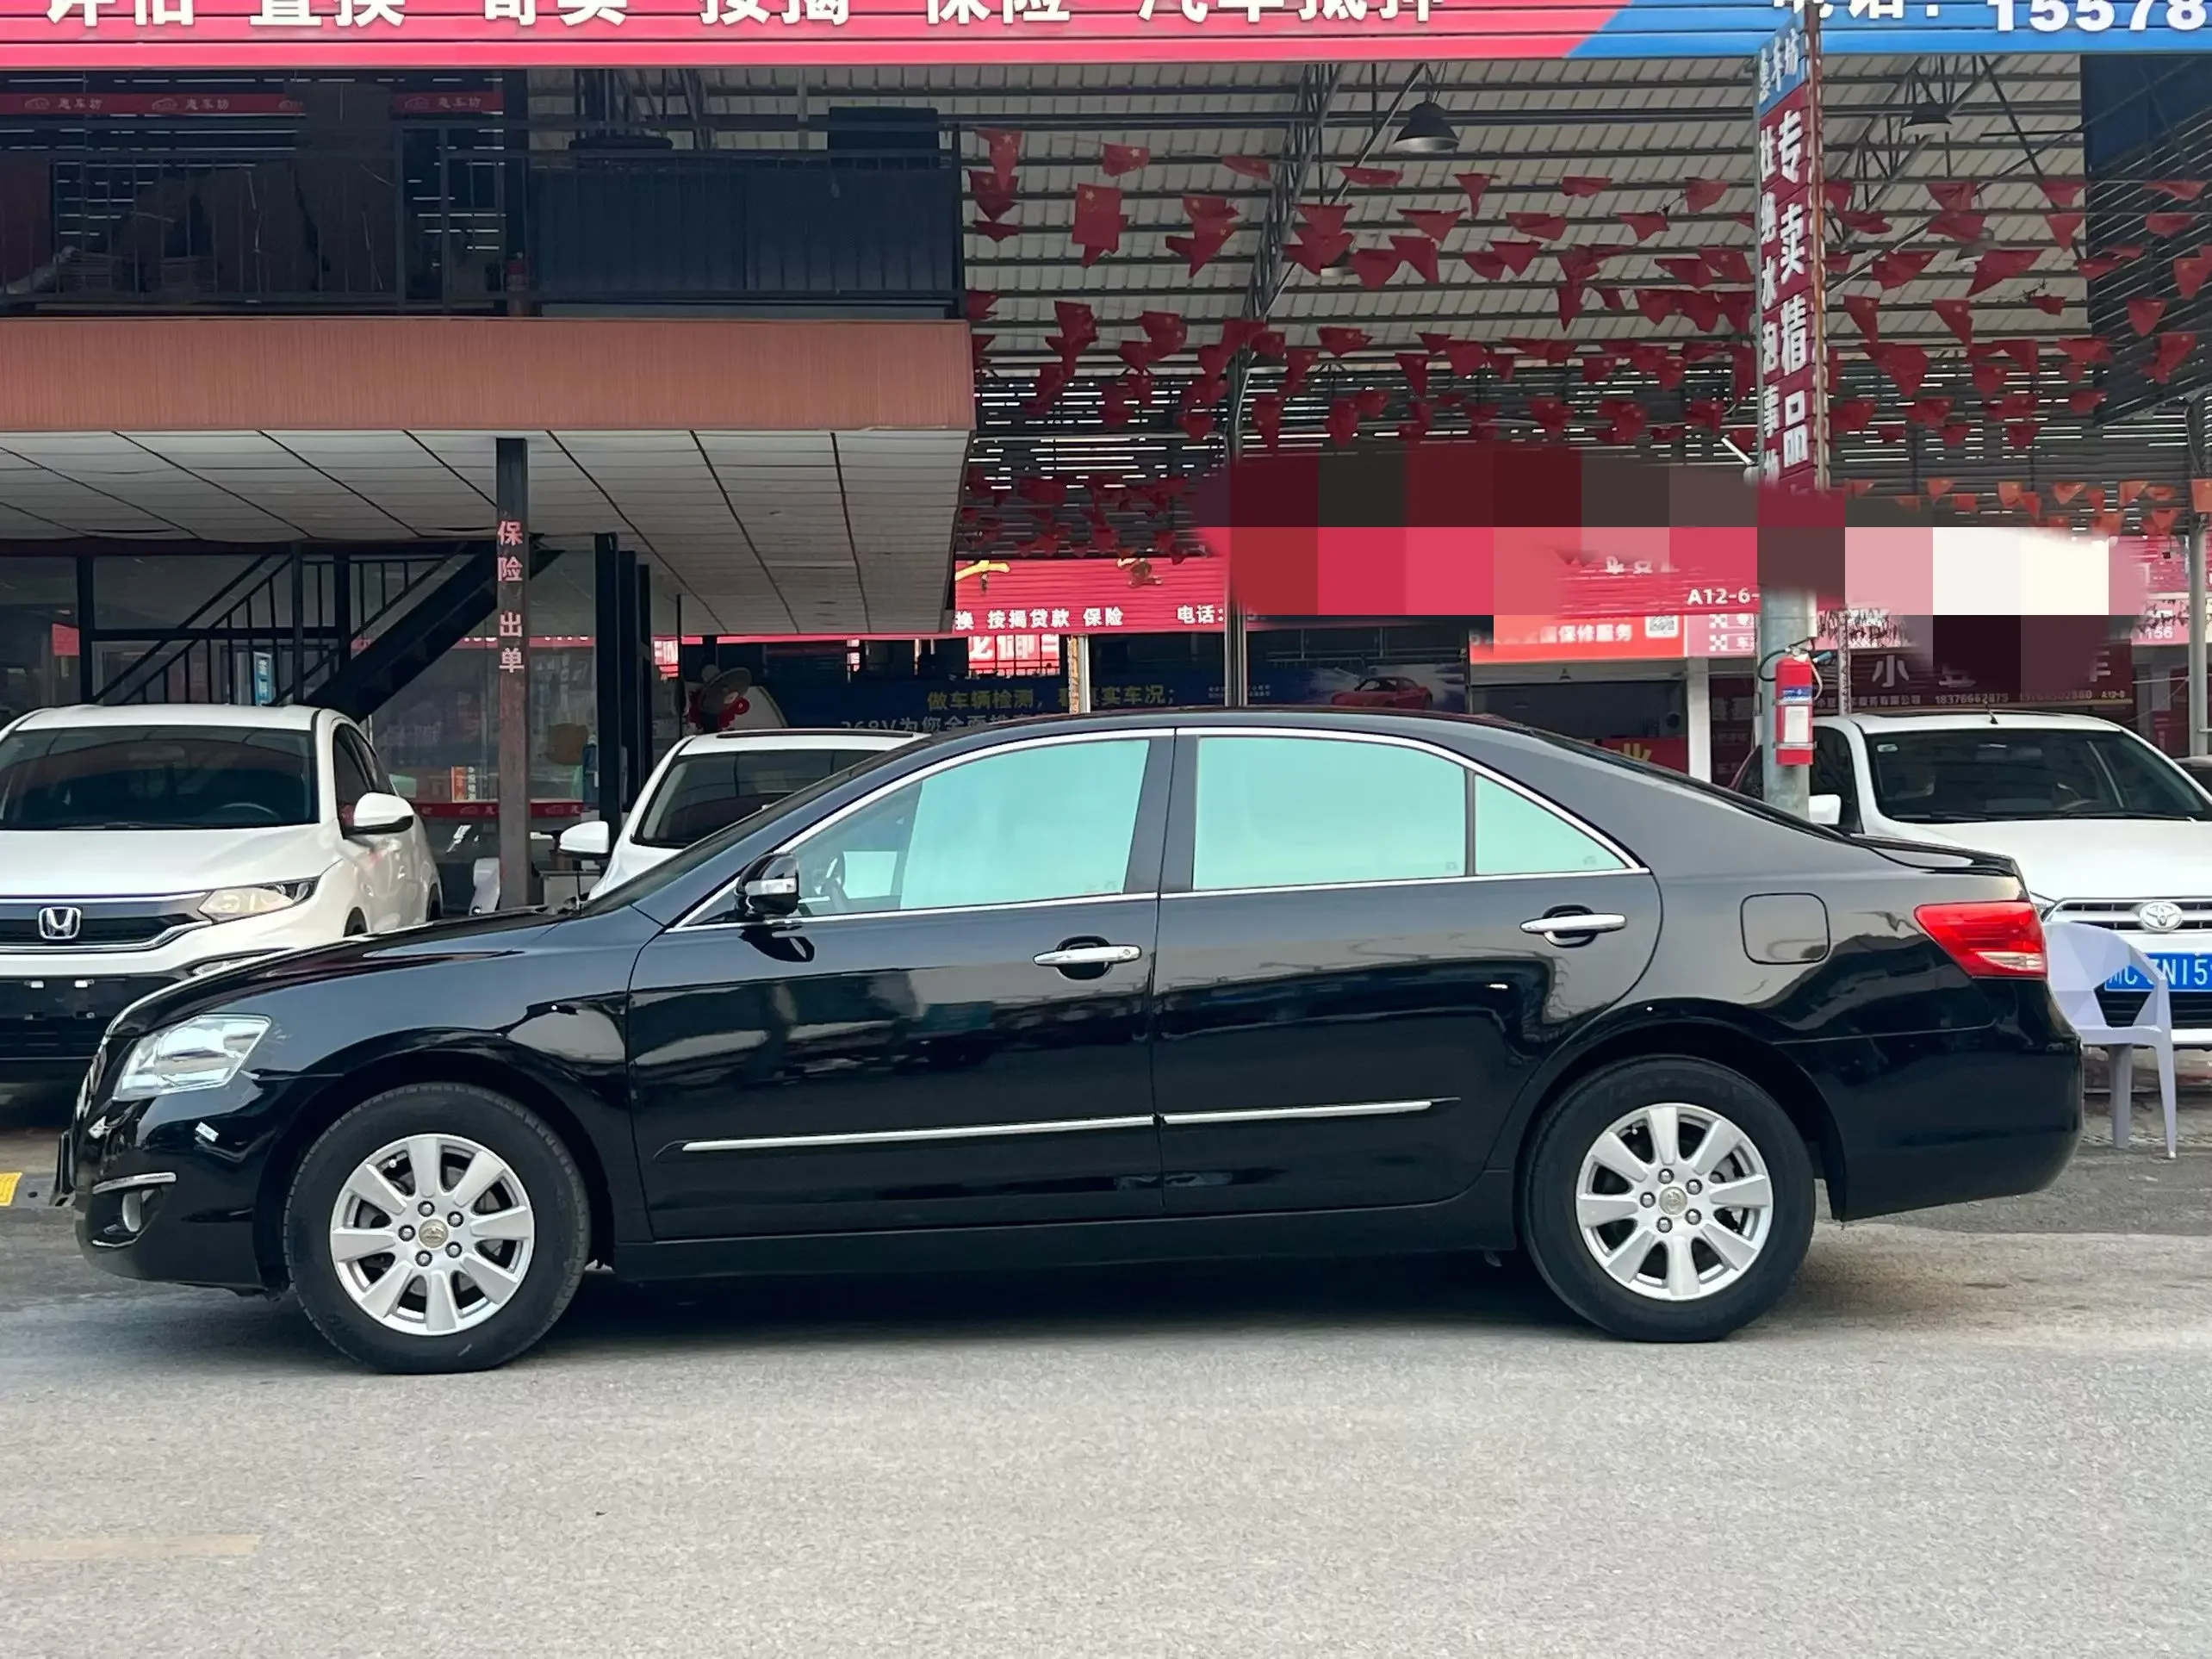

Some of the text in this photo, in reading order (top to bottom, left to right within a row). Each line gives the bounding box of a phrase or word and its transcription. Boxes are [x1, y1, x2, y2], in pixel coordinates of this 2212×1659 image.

[1777, 109, 1808, 468] 专卖精品
[497, 520, 525, 673] 保险 出单
[955, 610, 974, 631] 换
[988, 607, 1070, 630] 按揭贷款
[1083, 606, 1123, 627] 保险
[1177, 605, 1223, 624] 电话:
